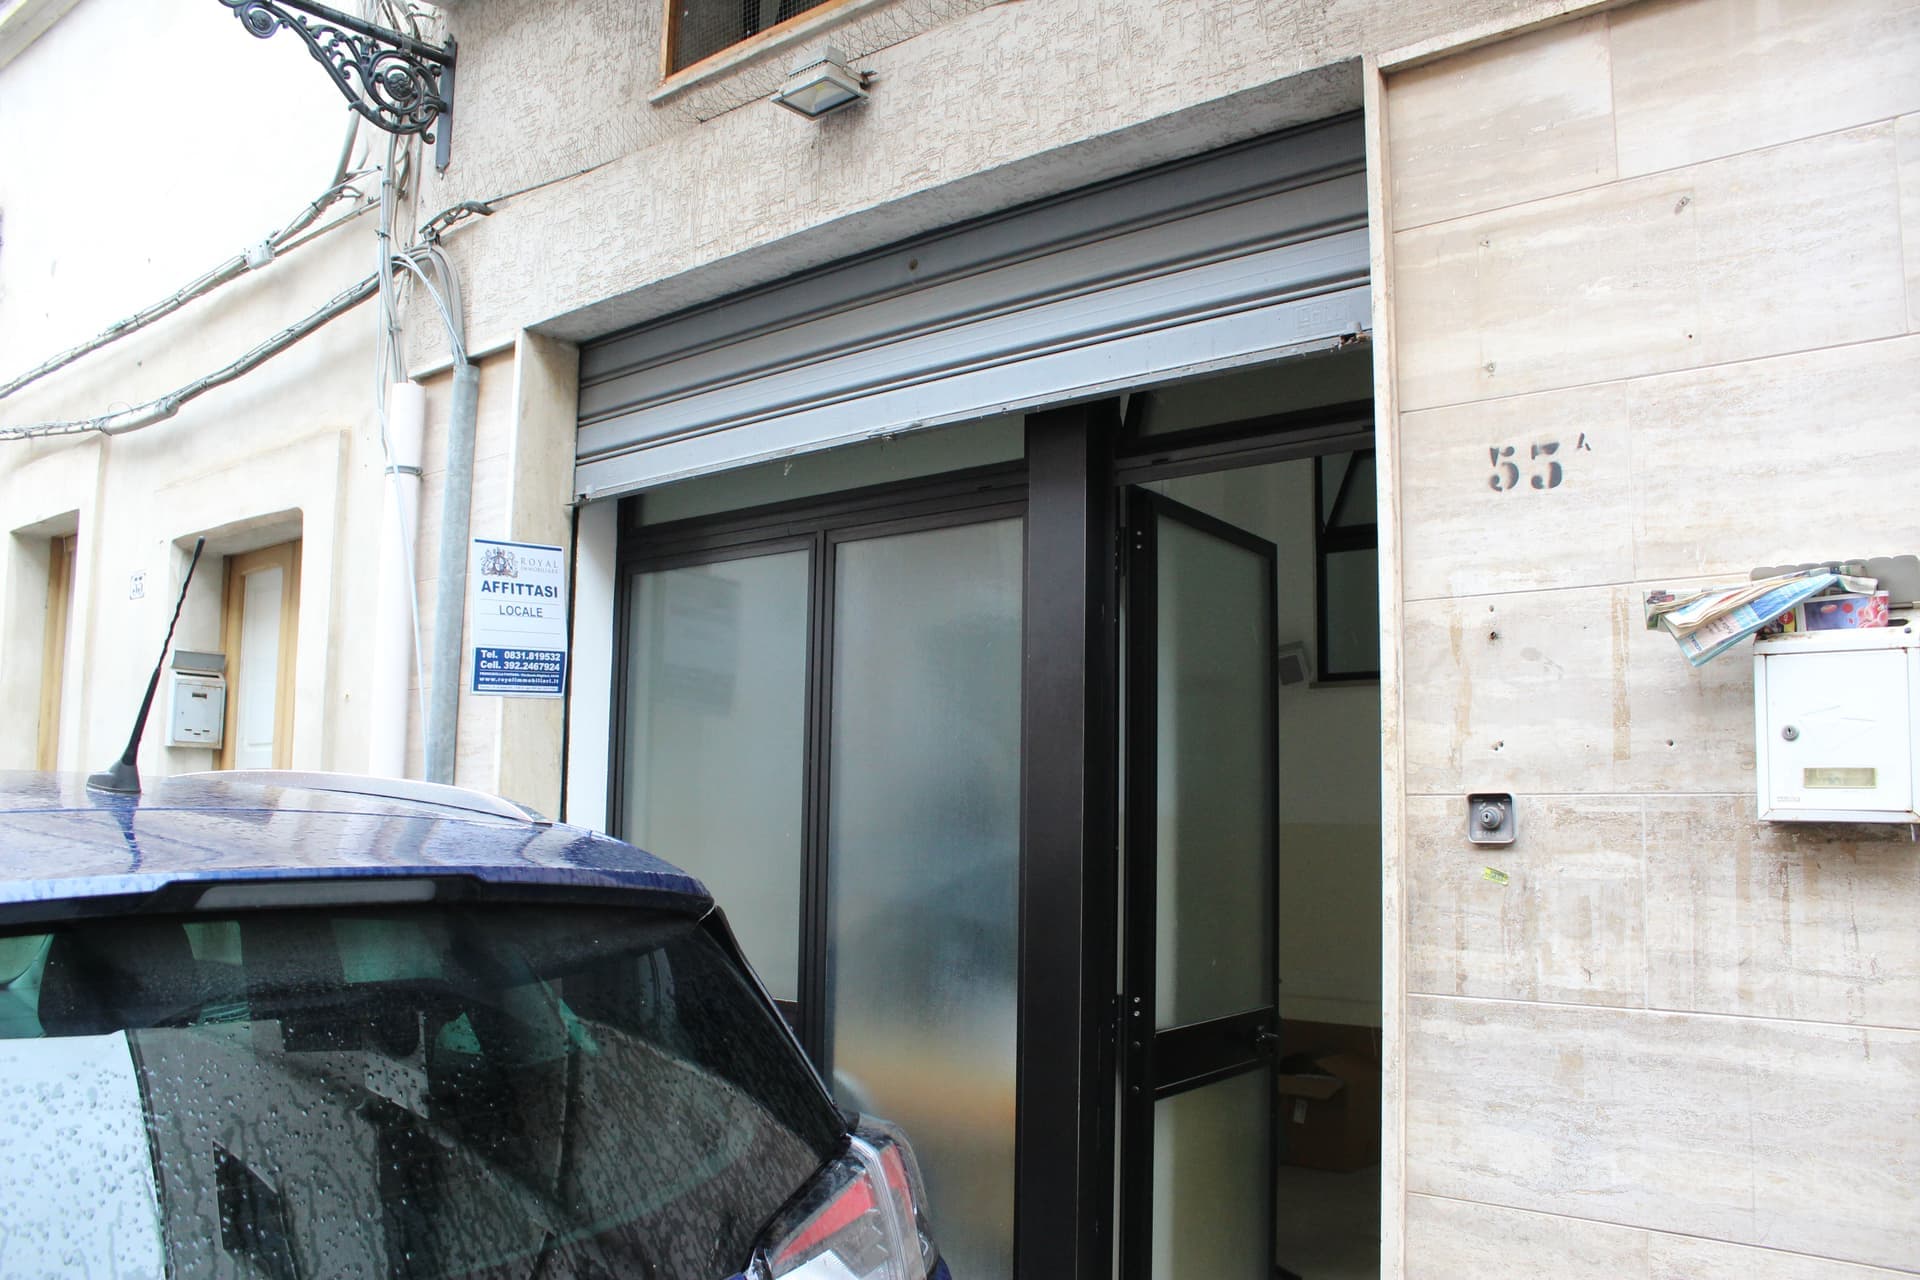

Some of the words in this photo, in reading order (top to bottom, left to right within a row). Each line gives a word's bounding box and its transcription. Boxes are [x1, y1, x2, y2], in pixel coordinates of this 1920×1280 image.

[520, 557, 559, 569] ROYAL
[481, 580, 558, 598] AFFITTASI
[499, 605, 543, 618] LOCALE
[480, 649, 498, 659] Tel.
[504, 650, 561, 662] 0831.819532
[480, 660, 502, 669] Cell.
[503, 661, 560, 671] 392.2467924
